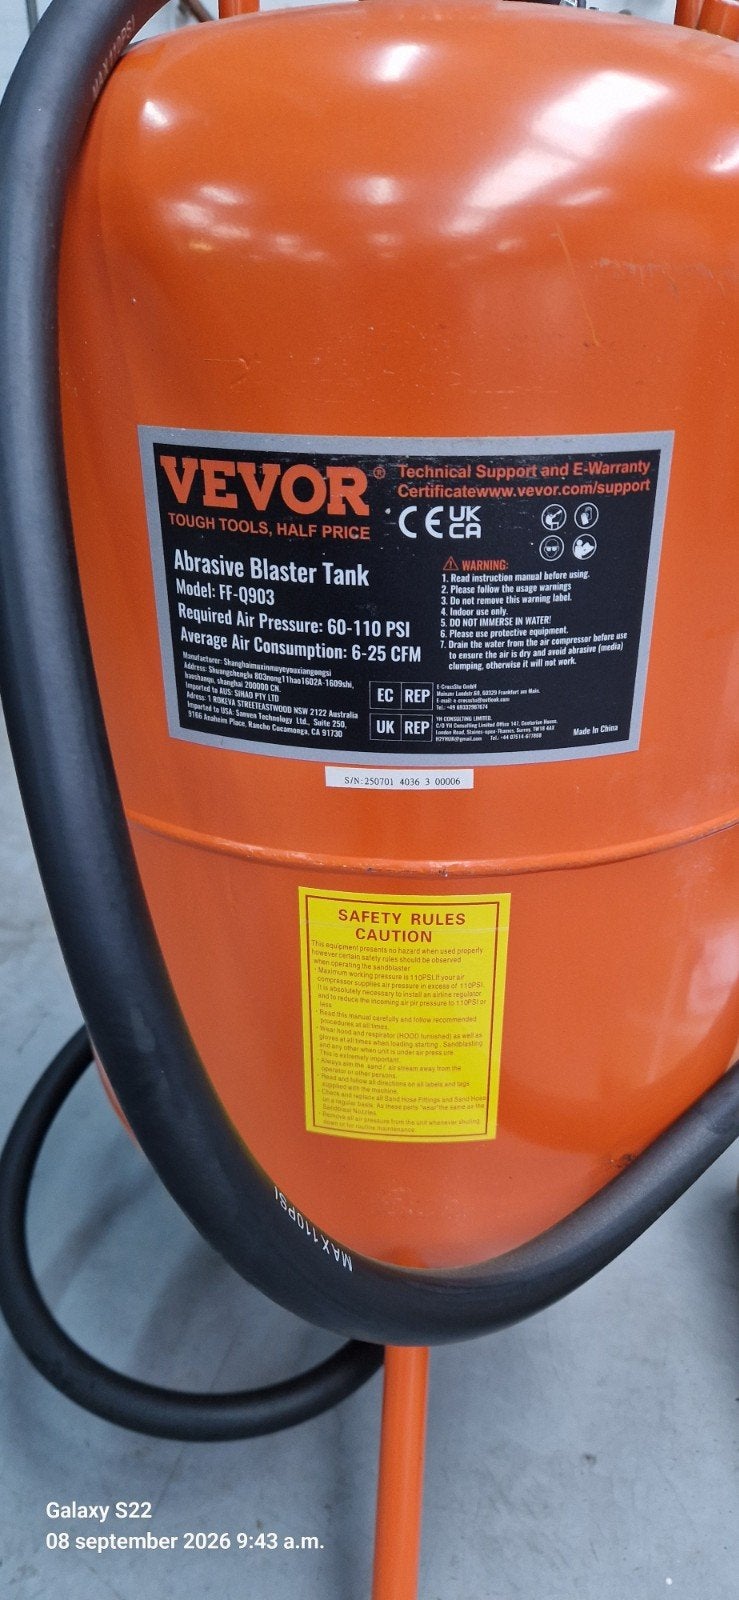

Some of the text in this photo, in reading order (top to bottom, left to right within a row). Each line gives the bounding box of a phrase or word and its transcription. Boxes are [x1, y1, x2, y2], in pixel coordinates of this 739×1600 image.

[399, 460, 650, 480] Technical Support and E-Warranty
[160, 455, 370, 516] VEVOR
[398, 479, 650, 498] Certificatewww.vevor.com/support
[450, 506, 481, 521] UK
[168, 512, 370, 540] TOUGH TOOLS, HALF PRICE
[399, 506, 443, 538] CE
[450, 523, 481, 538] CA
[174, 549, 369, 586] Abrasive Blaster Tank
[462, 559, 508, 571] WARNING:
[442, 570, 590, 583] 1. Read instruction manual before using.
[176, 579, 275, 606] Model: FF-Q903
[441, 583, 571, 594] 2. Please follow the usage warnings
[441, 593, 571, 605] 3. Do not remove this warning label.
[441, 607, 508, 616] 4. Indoor use only.
[178, 603, 410, 637] Required Air Pressure: 60-110 PSI
[441, 616, 551, 627] 5. DO NOT IMMERSE IN WATER!
[440, 626, 568, 638] 6. Please use protective equipment.
[181, 627, 421, 662] Average Air Consumption: 6-25 CFM
[440, 641, 446, 649] 7.
[449, 640, 468, 649] Drain
[470, 640, 482, 648] the
[484, 639, 505, 648] water
[507, 638, 524, 647] from
[526, 638, 538, 646] the
[540, 637, 549, 646] air
[552, 635, 591, 645] compressor
[593, 633, 614, 642] before
[519, 649, 530, 658] dry
[533, 648, 546, 657] and
[548, 648, 566, 656] avoid
[568, 645, 596, 654] abrasive
[599, 642, 623, 653] (media)
[449, 662, 484, 671] clumping,
[486, 661, 520, 669] otherwise
[530, 659, 543, 668] will
[545, 658, 556, 667] not
[558, 657, 576, 666] work.
[186, 681, 210, 694] Imported
[220, 687, 233, 696] AUS:
[377, 688, 393, 702] EC
[405, 689, 430, 703] REP
[238, 699, 292, 713] STREETEASTWOOD
[310, 709, 327, 717] 2122
[204, 714, 227, 724] Anaheim
[248, 721, 270, 731] Rancho
[377, 720, 430, 734] UK REP
[574, 727, 590, 736] Made
[600, 724, 618, 733] China
[339, 909, 465, 925] SAFETY RULES
[356, 928, 432, 942] CAUTION
[312, 949, 337, 957] however
[326, 942, 358, 951] equipment
[318, 967, 347, 976] Maximum
[331, 961, 360, 969] operating
